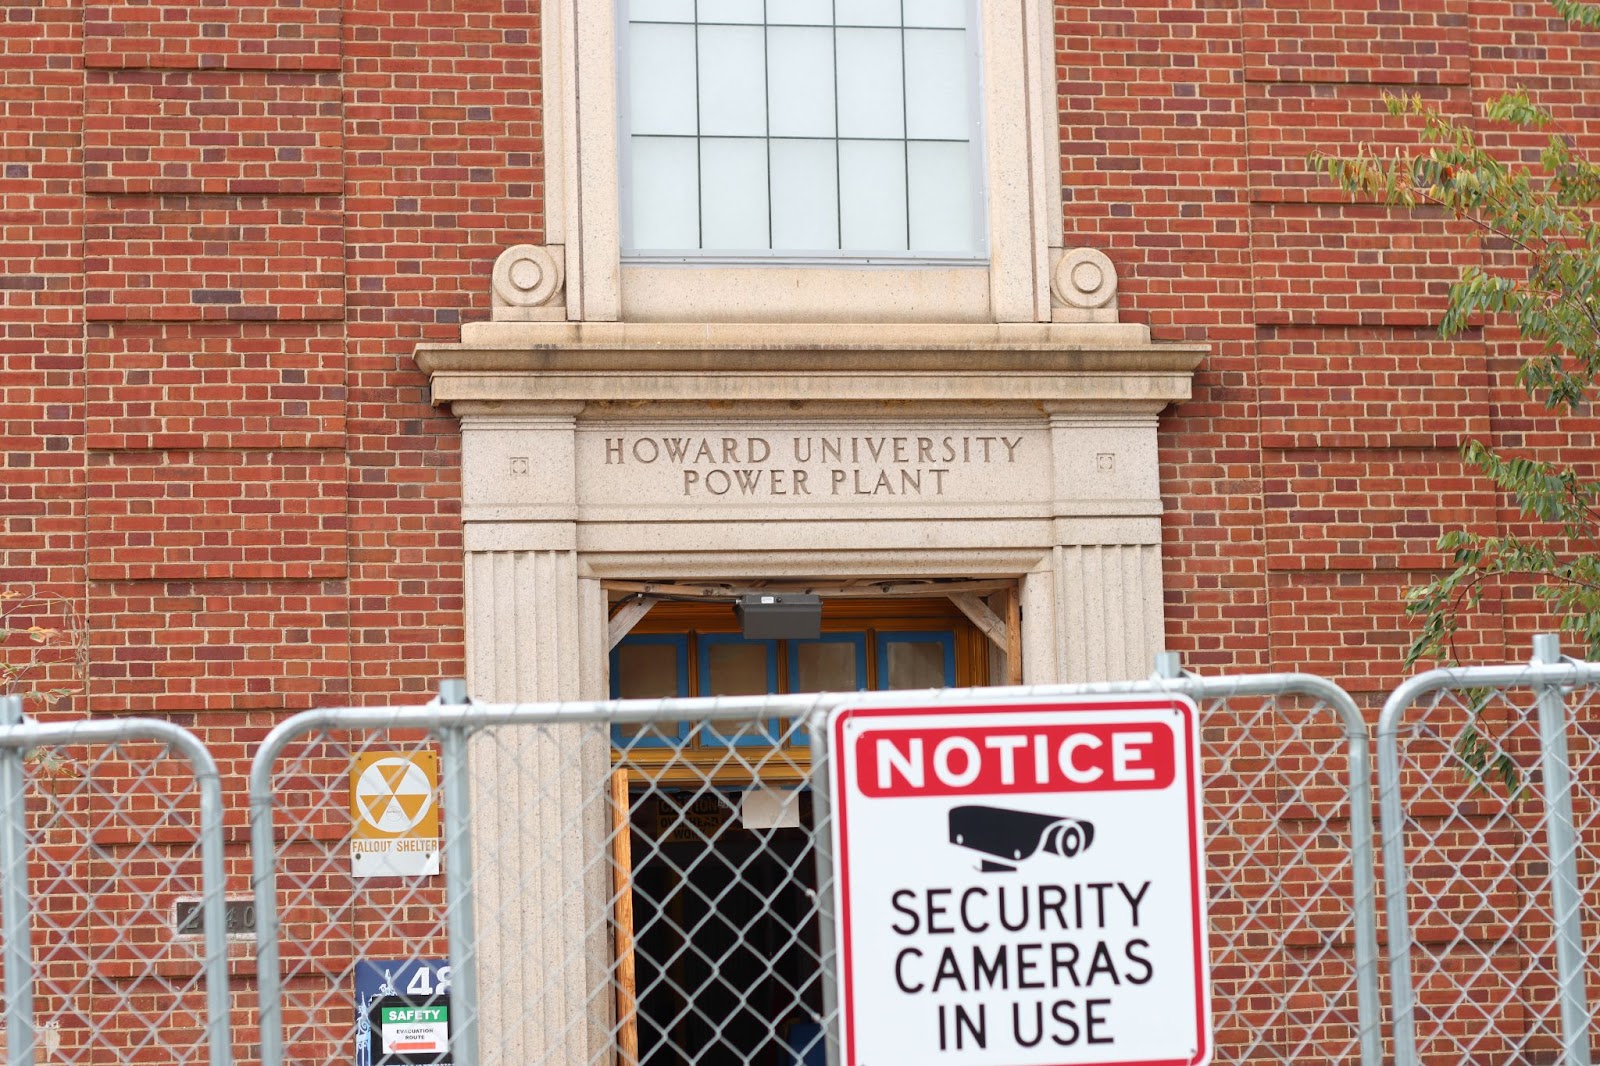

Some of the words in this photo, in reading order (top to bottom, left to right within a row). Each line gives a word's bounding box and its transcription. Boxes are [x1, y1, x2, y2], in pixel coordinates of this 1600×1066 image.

[604, 436, 771, 465] HOWARD
[793, 436, 1024, 464] UNIVERSITY
[683, 468, 812, 496] POWER
[830, 468, 950, 495] PLANT
[876, 731, 1156, 789] NOTICE
[352, 840, 392, 853] FALLOUT
[396, 839, 437, 852] SHELTER
[186, 905, 256, 929] 240
[891, 880, 1152, 936] SECURITY
[895, 938, 1154, 994] CAMERAS
[388, 1009, 440, 1021] SAFETY
[938, 1003, 987, 1051] IN
[1011, 998, 1115, 1048] USE
